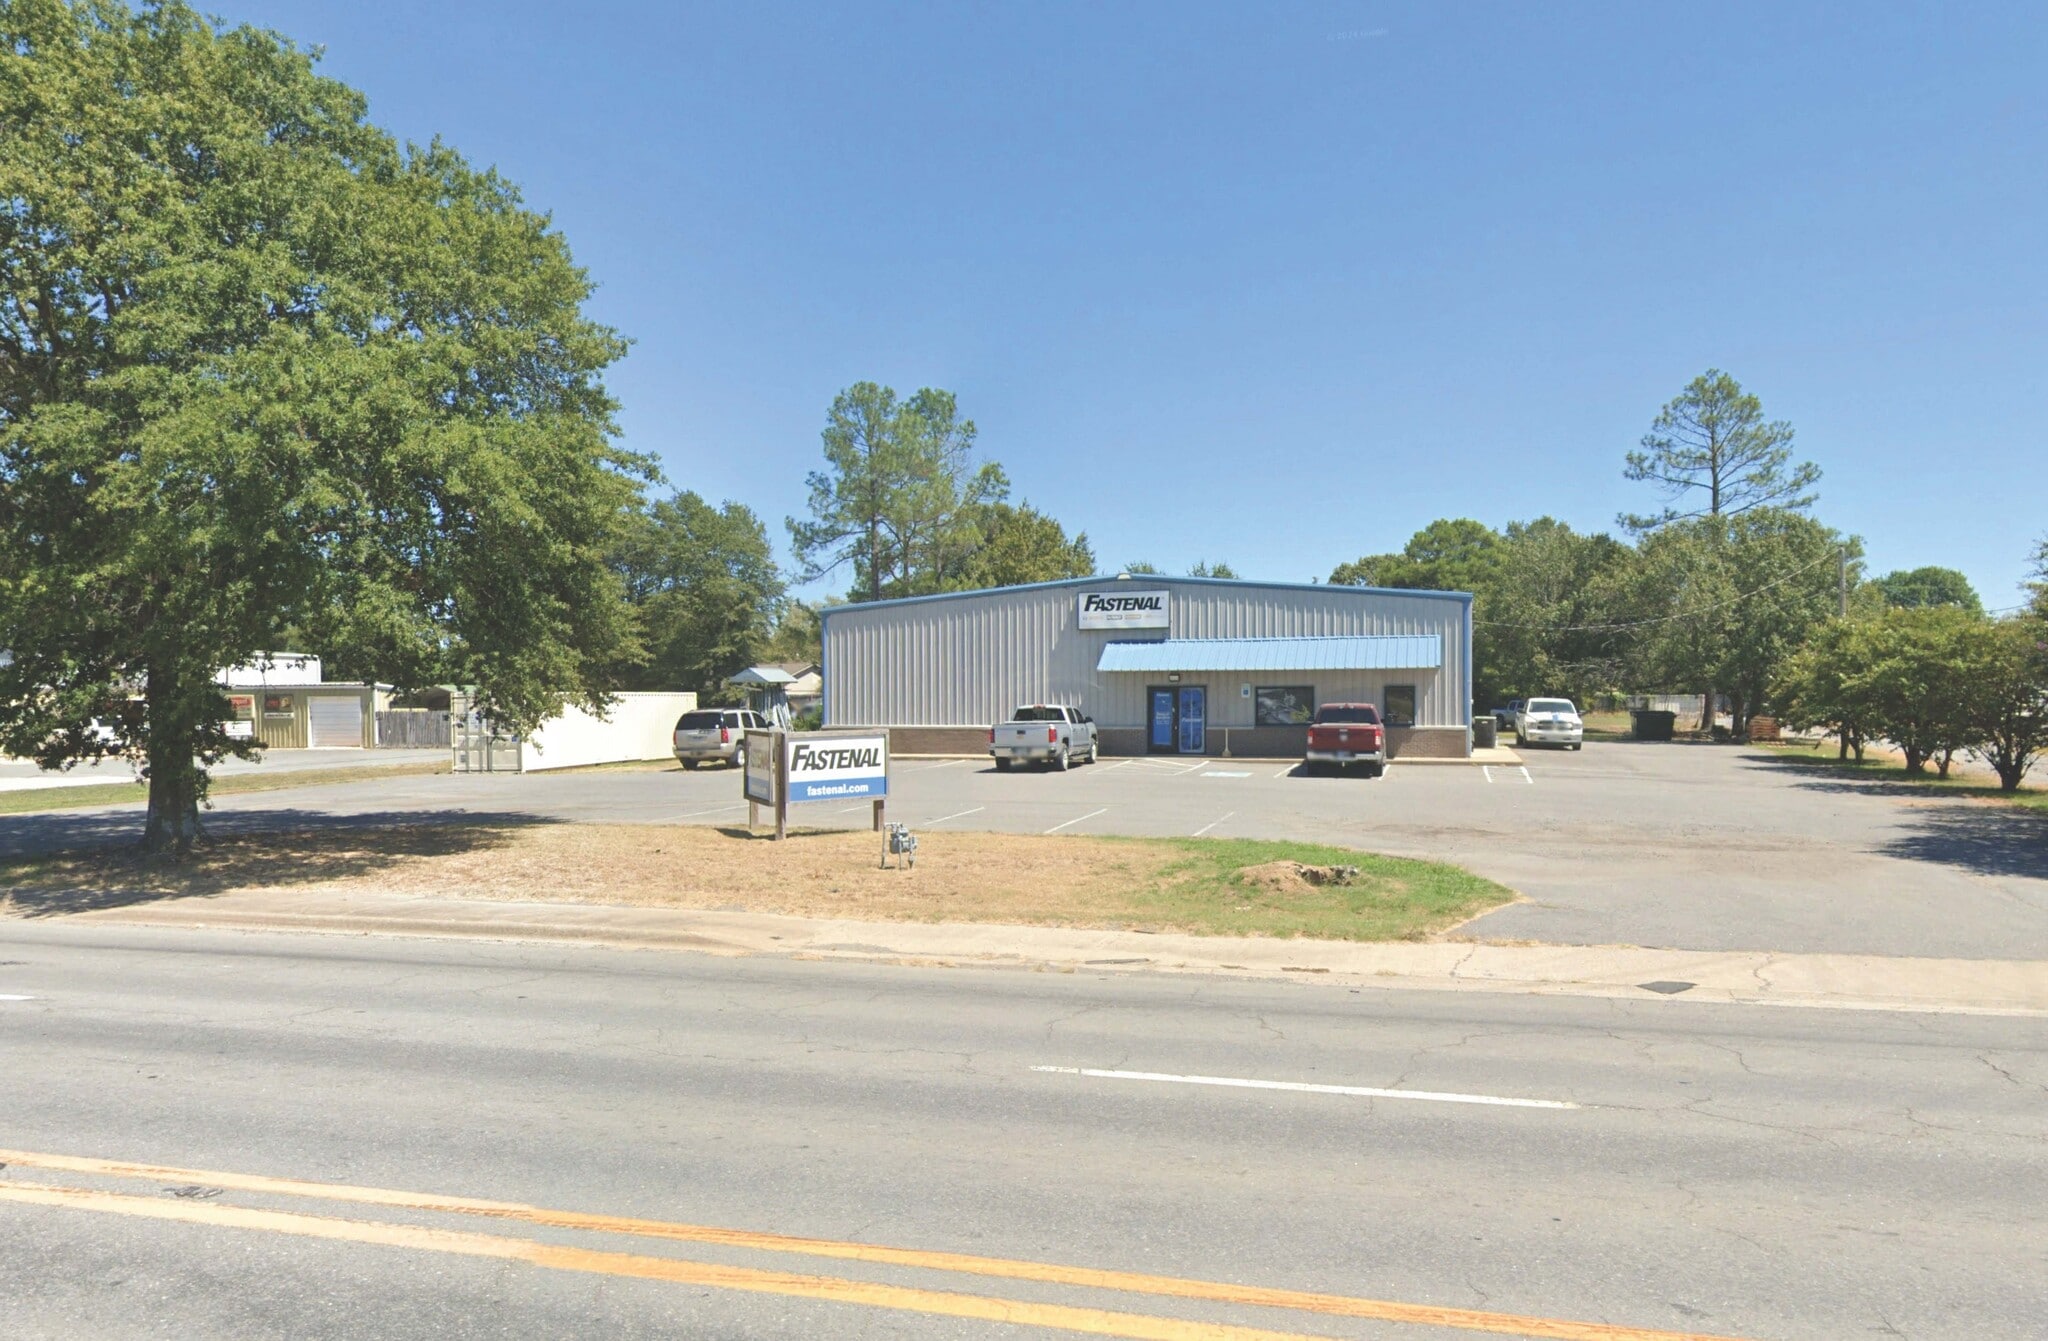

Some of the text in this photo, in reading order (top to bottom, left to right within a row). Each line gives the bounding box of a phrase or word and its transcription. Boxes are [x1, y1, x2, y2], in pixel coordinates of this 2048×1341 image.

[1084, 594, 1162, 612] FASTENAL
[790, 744, 882, 772] FASTENAL
[806, 783, 869, 797] fastenal.com
